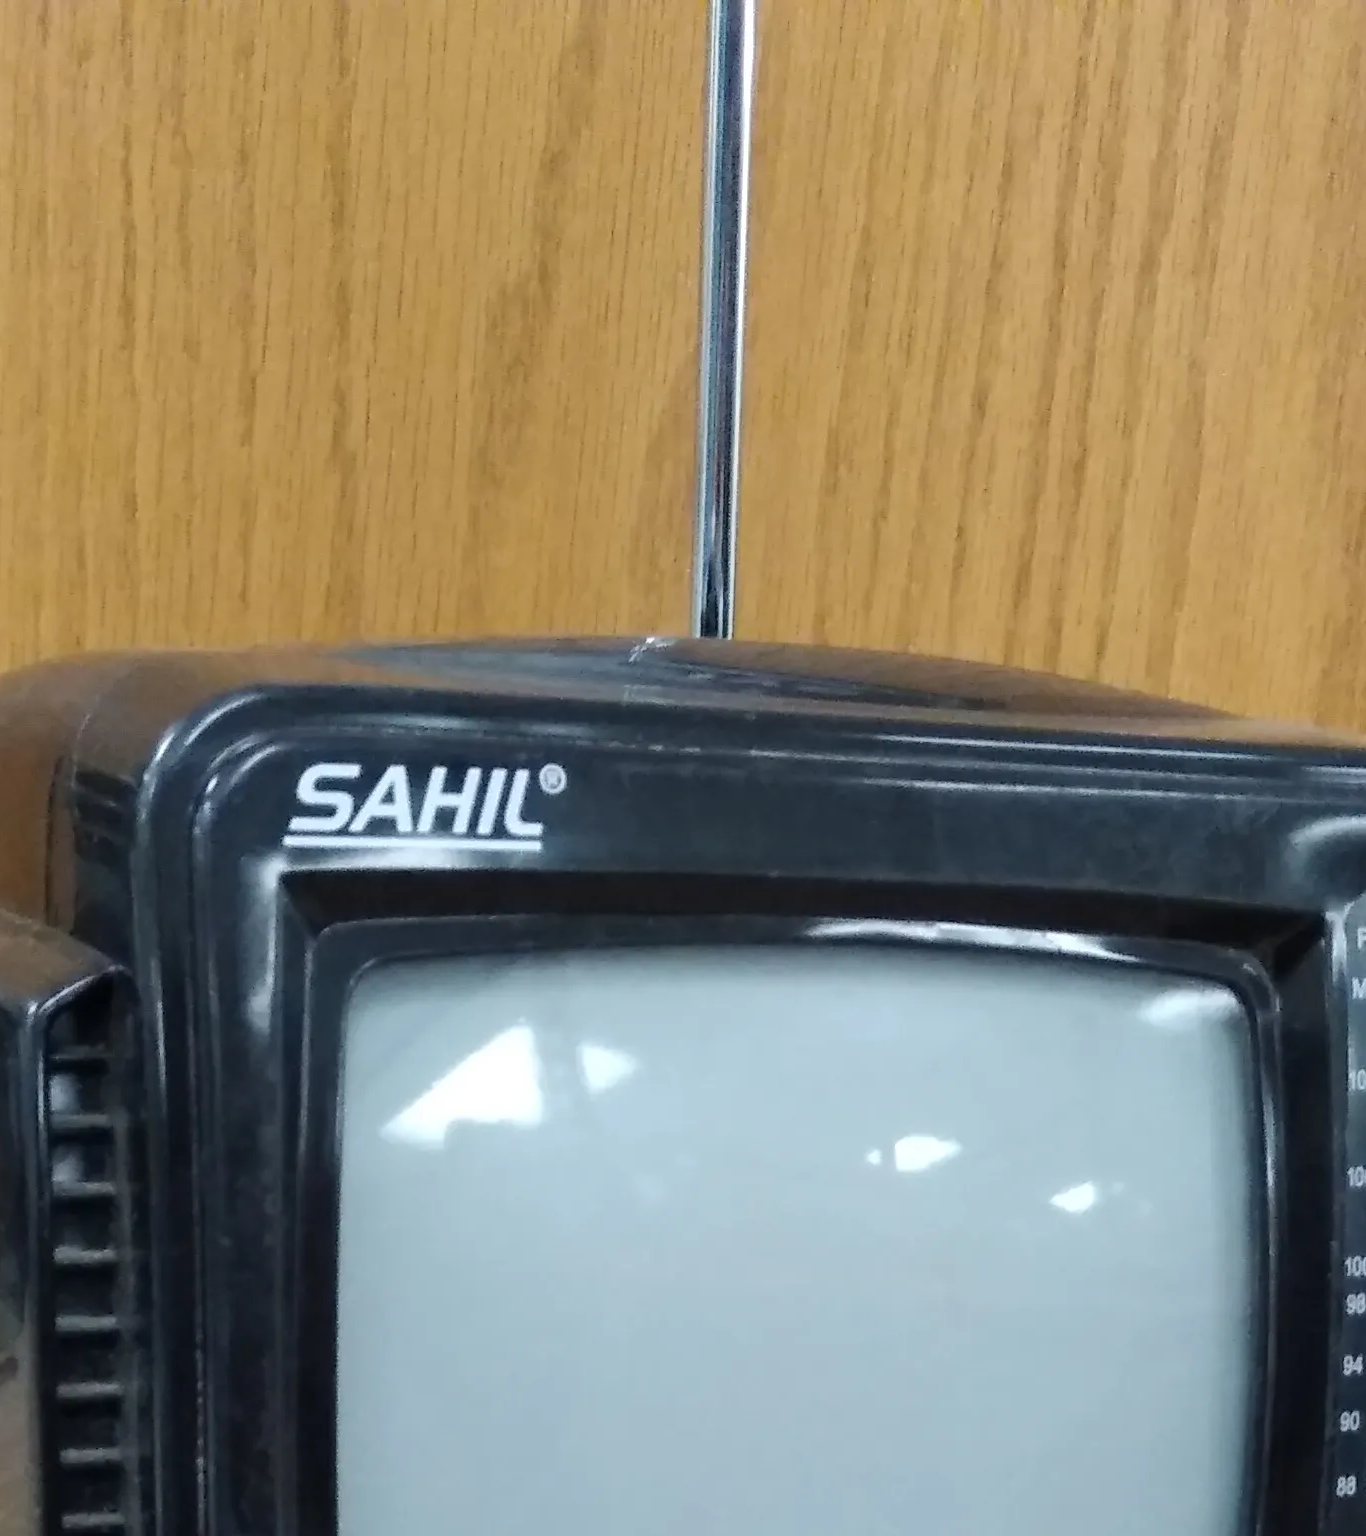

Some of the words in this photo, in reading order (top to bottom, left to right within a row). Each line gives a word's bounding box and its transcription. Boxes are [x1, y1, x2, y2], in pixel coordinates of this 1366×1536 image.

[1343, 1354, 1364, 1377] 94
[1339, 1410, 1360, 1432] 90
[1336, 1475, 1357, 1497] 88
